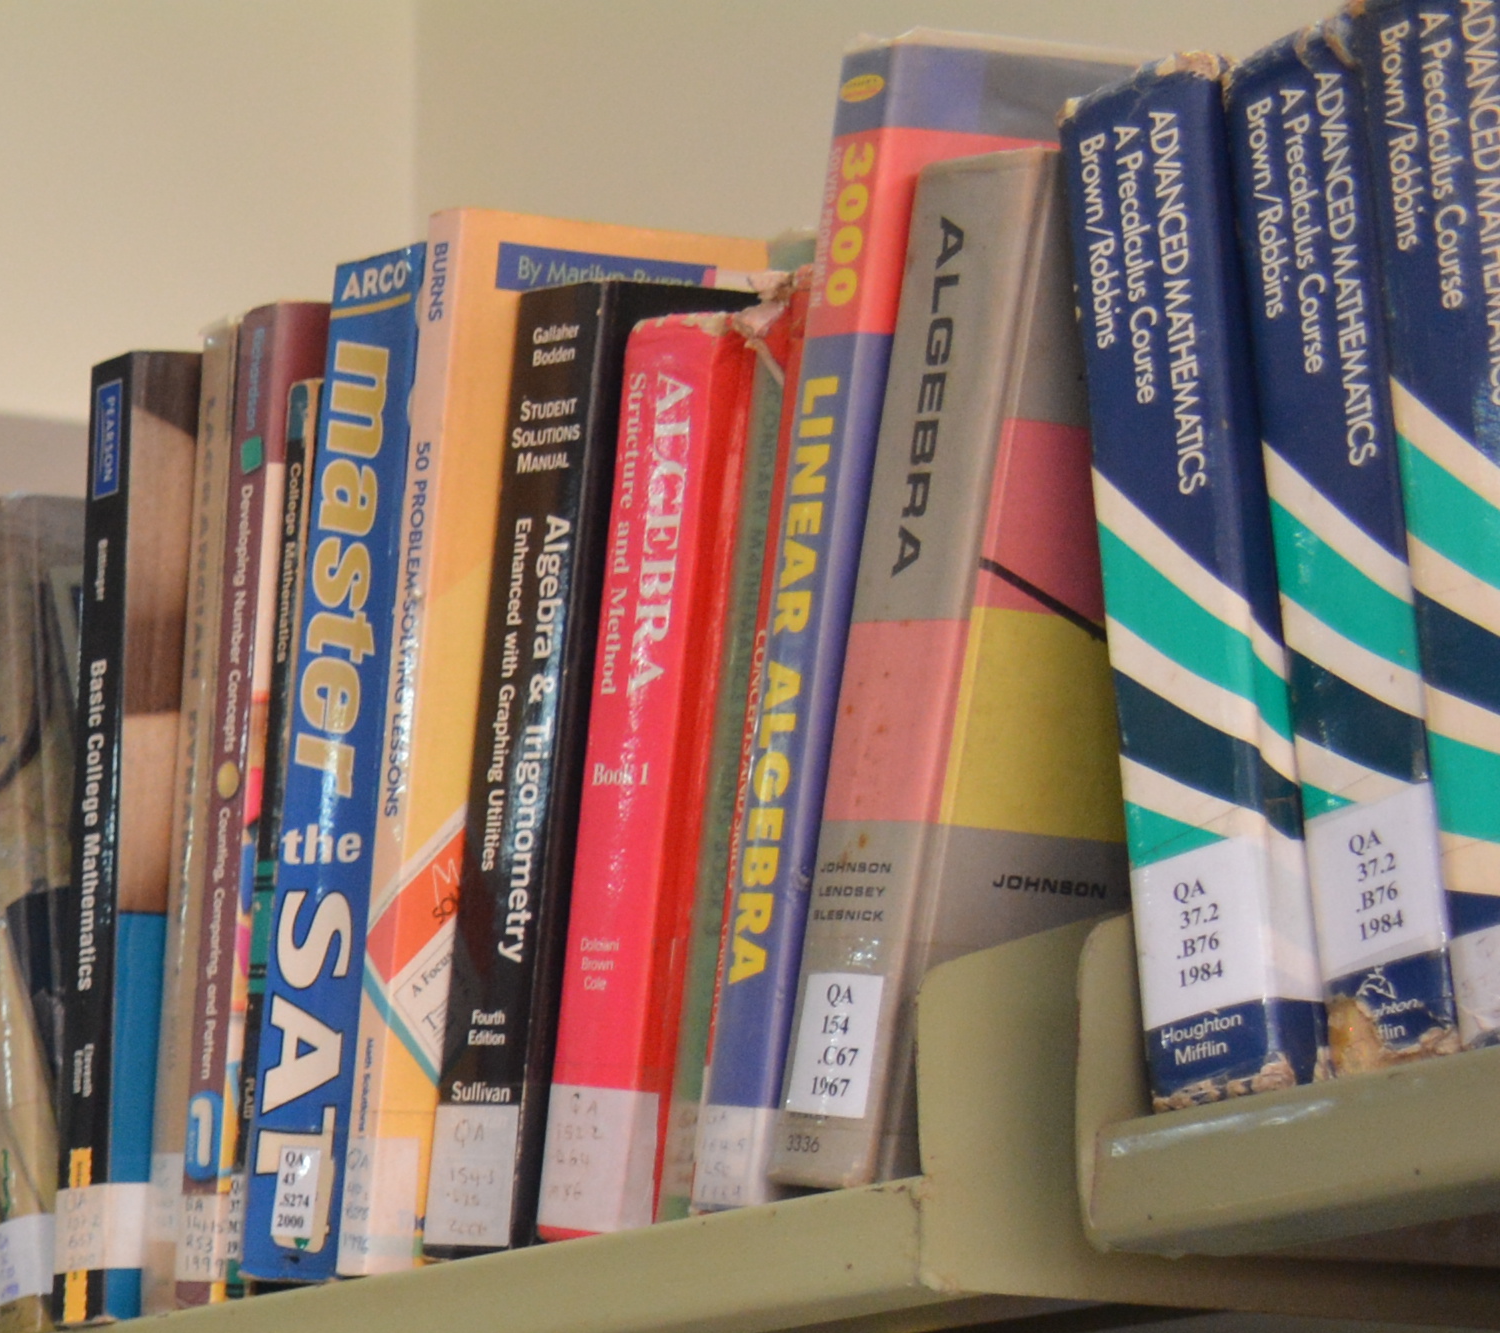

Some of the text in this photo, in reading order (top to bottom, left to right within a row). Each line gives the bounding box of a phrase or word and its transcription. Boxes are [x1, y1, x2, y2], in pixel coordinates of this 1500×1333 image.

[825, 142, 874, 306] 3000
[1079, 133, 1114, 350] Brown/Robbins
[340, 260, 408, 302] ARCO
[427, 241, 450, 322] BURNS
[1114, 127, 1154, 403] A Precalculus Course
[1148, 111, 1206, 495] ADVANCED MATHEMATICS
[520, 398, 577, 421] STUDENT
[891, 217, 964, 576] ALGEBRA
[511, 424, 580, 449] SOLUTIONS
[415, 441, 432, 473] 50
[517, 452, 569, 474] MANUAL
[601, 372, 647, 695] Structure and Method
[626, 373, 693, 696] ALGEBRA
[296, 342, 384, 801] master
[481, 518, 531, 871] Enhanced with Graphing Utilities
[728, 375, 839, 984] LINEAR ALGEBRA
[498, 513, 571, 963] Algebra & Trigonometry
[385, 712, 409, 818] LESSONS
[77, 658, 107, 992] Basic College Mathematics
[282, 831, 361, 866] the
[1173, 878, 1205, 902] QA
[1180, 904, 1220, 928] 37.2
[1177, 933, 1220, 961] .B76
[1178, 961, 1224, 988] 1984
[827, 984, 854, 1005] QA
[822, 1016, 849, 1035] 154
[1161, 1014, 1242, 1048] Houghton
[817, 1047, 858, 1066] .C67
[1174, 1039, 1229, 1066] Mifflin
[451, 1081, 510, 1103] Sullivan
[811, 1077, 850, 1096] 1967
